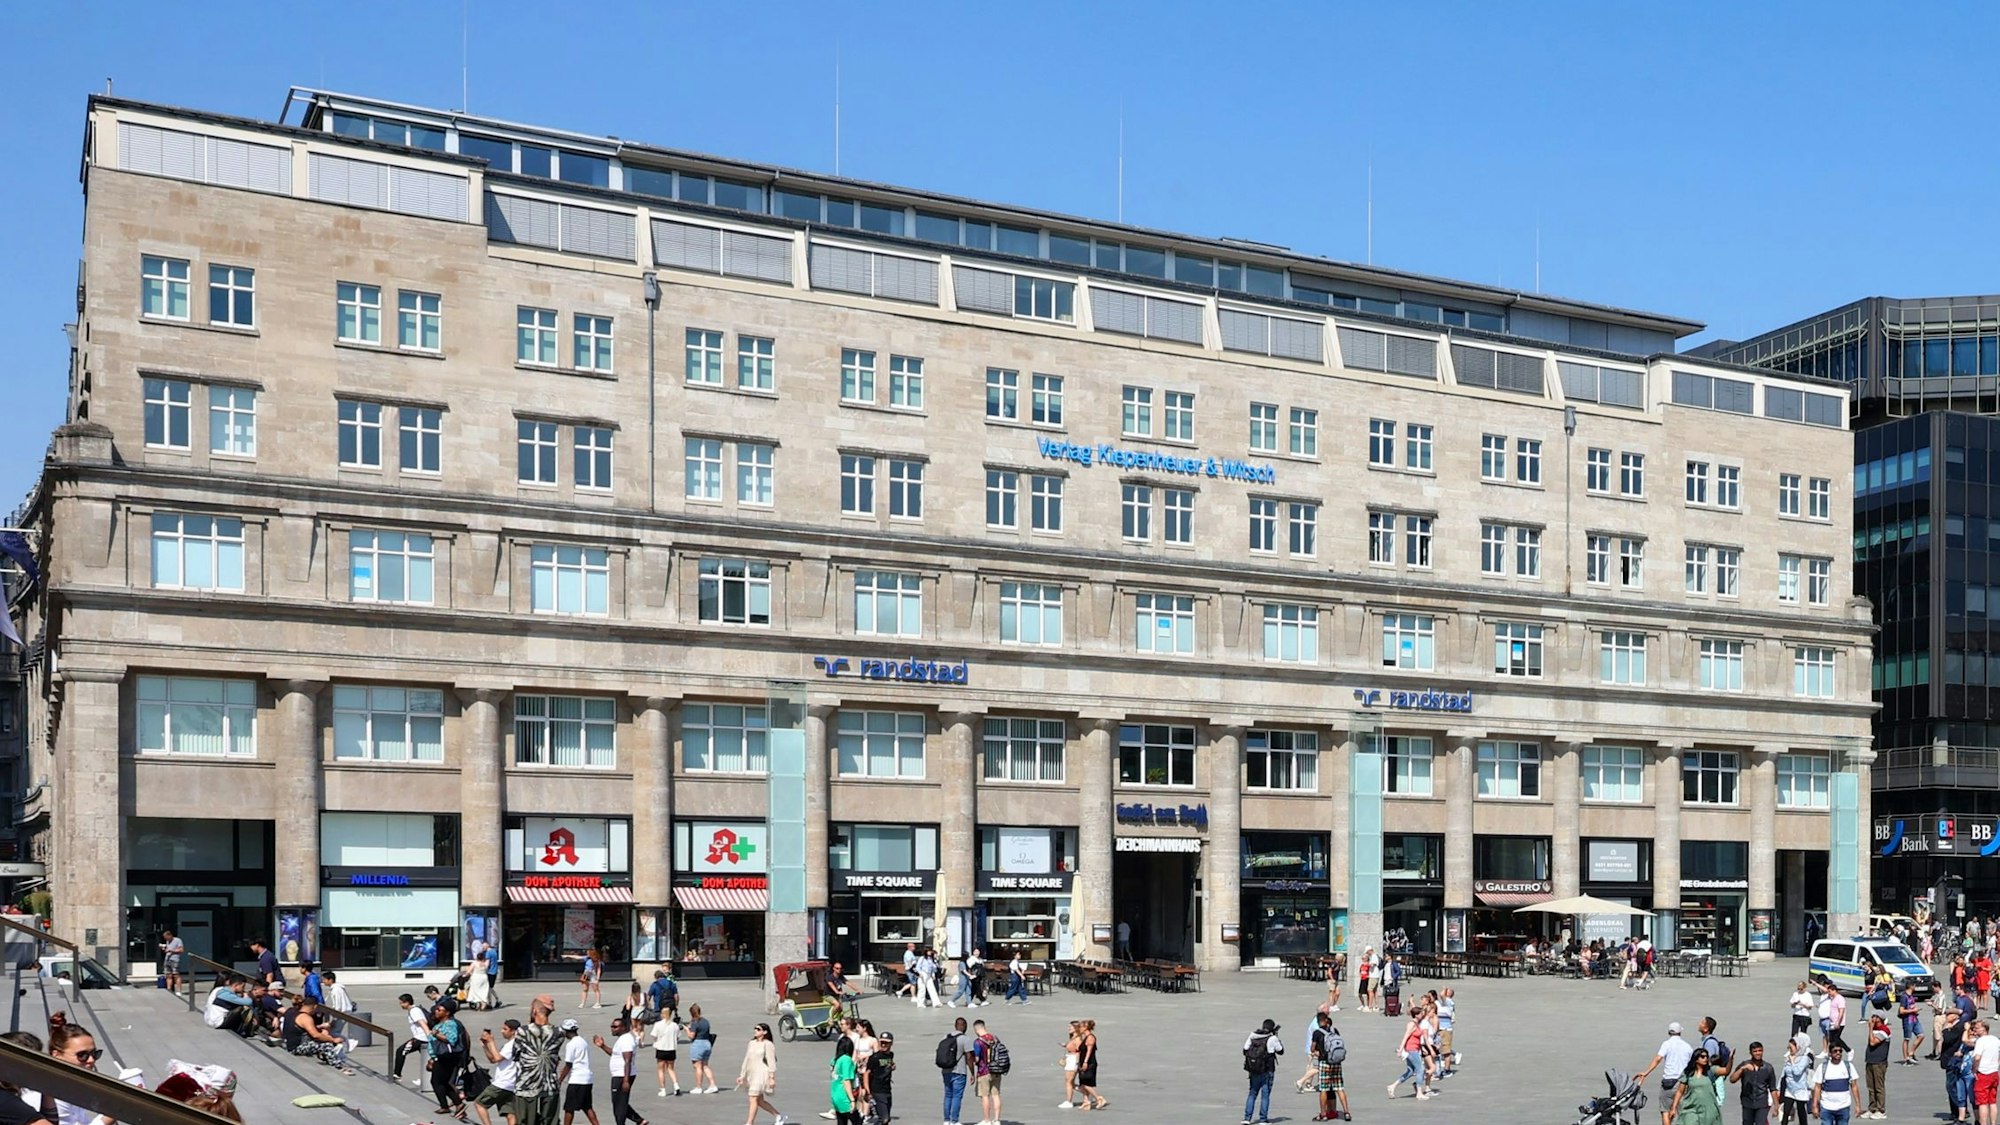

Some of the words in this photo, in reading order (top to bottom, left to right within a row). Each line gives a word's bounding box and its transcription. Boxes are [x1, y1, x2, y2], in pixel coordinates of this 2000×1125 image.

[1036, 435, 1093, 467] Verlag
[1098, 443, 1202, 475] Kiepenheuer
[1206, 456, 1218, 476] &
[1221, 458, 1276, 484] Witsch
[860, 656, 968, 685] randstad
[1389, 687, 1472, 713] randstad
[1875, 824, 1890, 840] BB
[1901, 834, 1929, 852] Bank
[1971, 824, 1992, 840] BB
[1115, 837, 1202, 853] DEICHMANNHAUS
[351, 874, 409, 885] MILLENIA
[524, 876, 549, 888] DOM
[551, 876, 602, 888] APOTHEKE
[702, 877, 725, 888] DOM
[727, 877, 769, 889] APOTHEK
[845, 876, 874, 887] TIME
[876, 876, 922, 888] SQUARE
[991, 877, 1018, 888] TIME
[1019, 878, 1063, 889] SQUARE
[1486, 882, 1540, 892] GALESTRO
